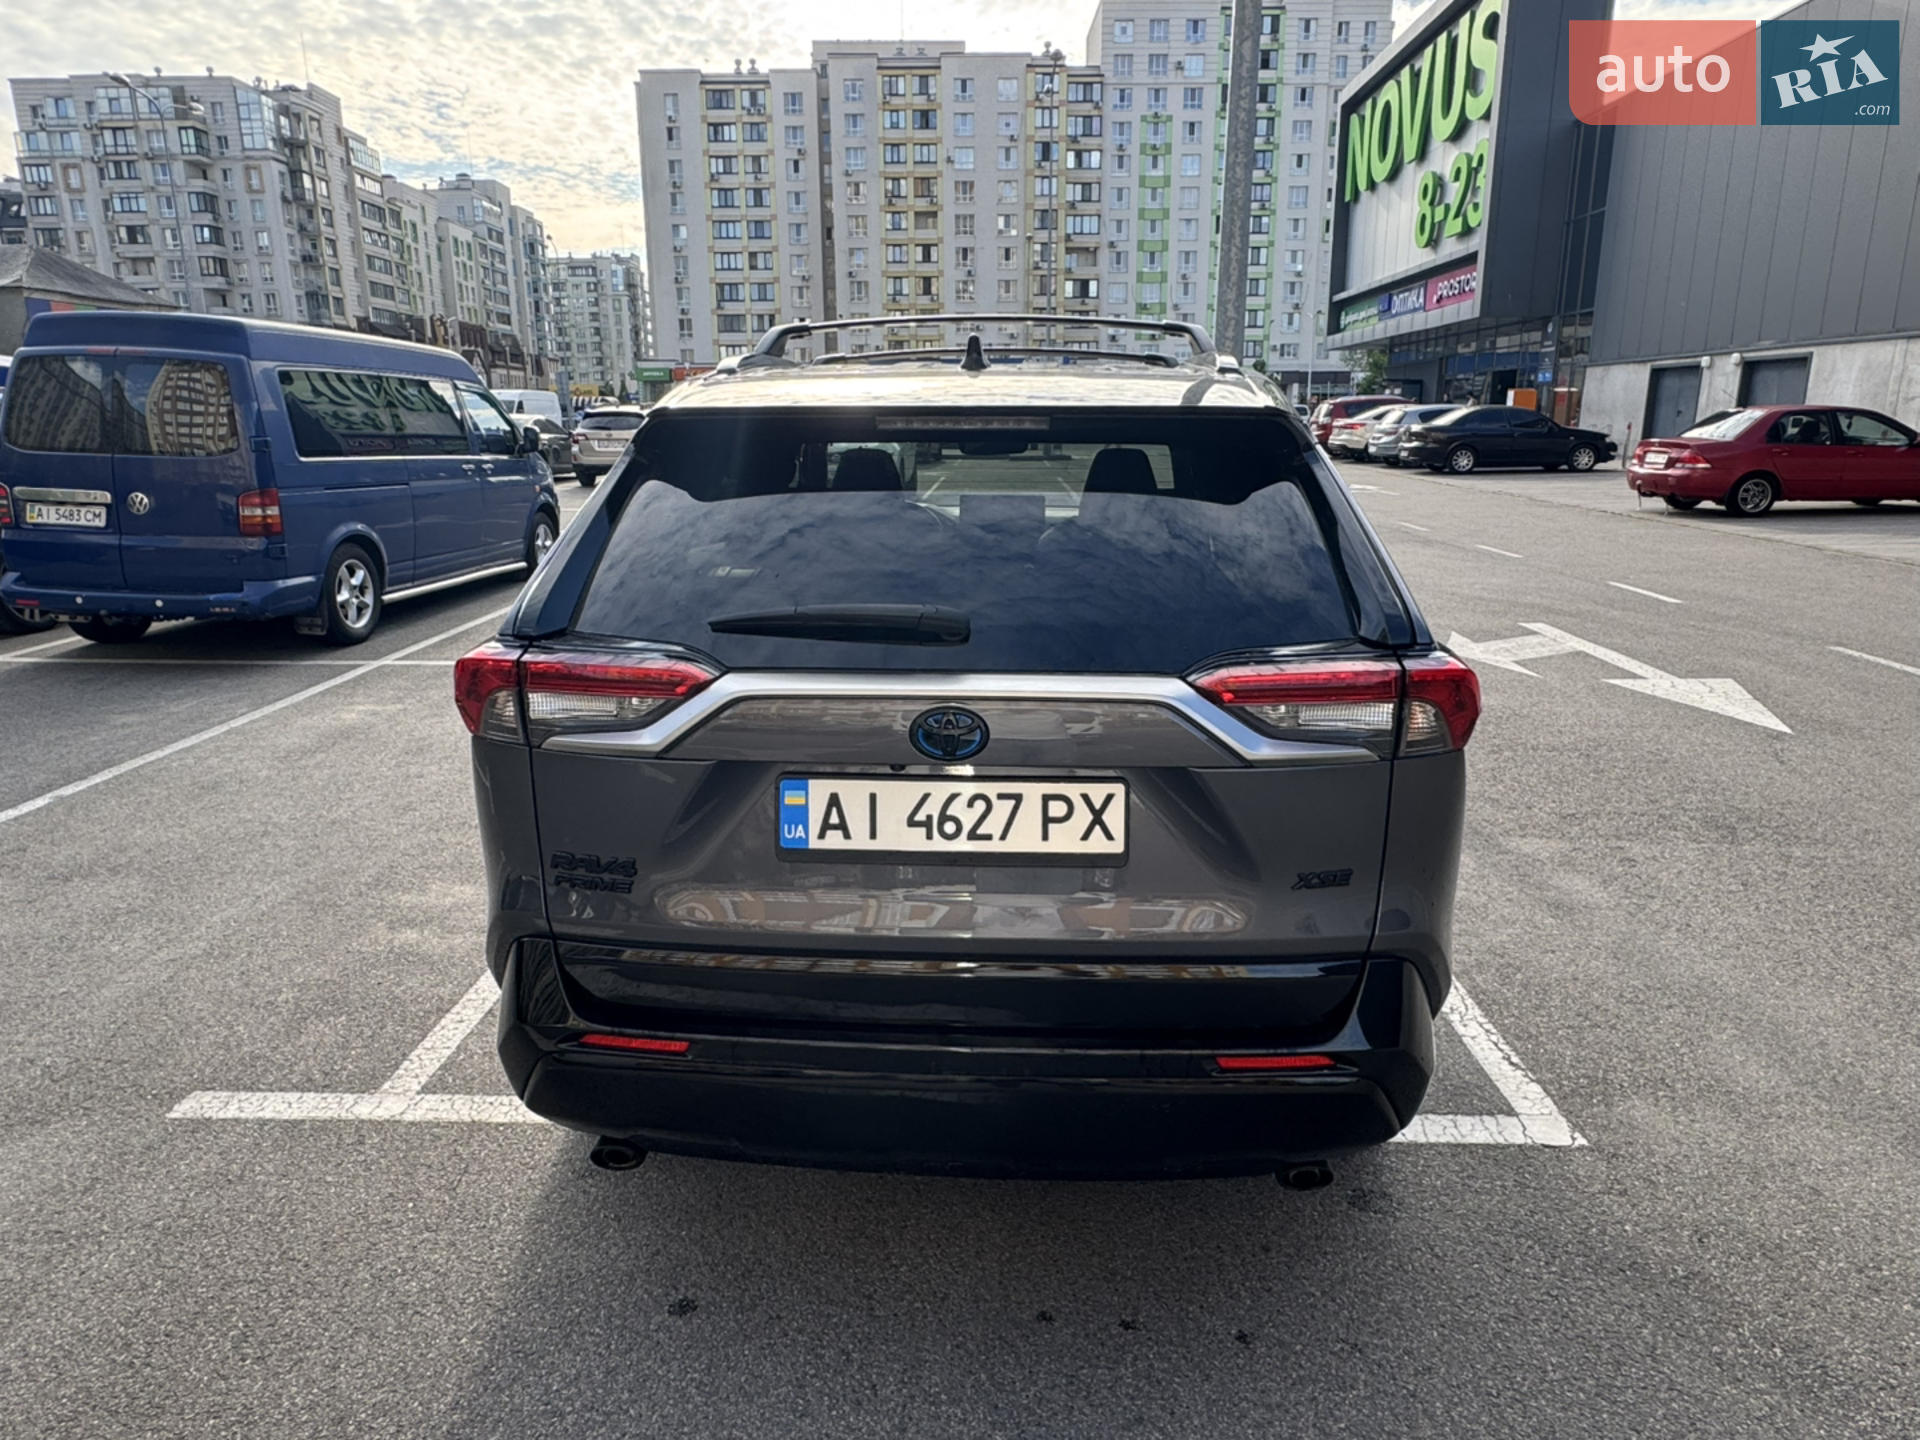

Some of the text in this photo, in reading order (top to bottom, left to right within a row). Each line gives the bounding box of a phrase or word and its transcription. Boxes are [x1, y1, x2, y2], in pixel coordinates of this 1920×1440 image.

[1345, 0, 1501, 202] NOVUS
[1415, 138, 1489, 248] 8-23
[1437, 271, 1477, 299] PROSTOR
[1391, 287, 1424, 314] ОПТИКА
[36, 507, 102, 523] AI 5483 CM
[816, 792, 1116, 841] AI 4627 PX
[784, 824, 806, 839] UA
[550, 850, 637, 878] RAV4
[554, 872, 634, 894] PRIME
[1290, 868, 1354, 890] XSE
